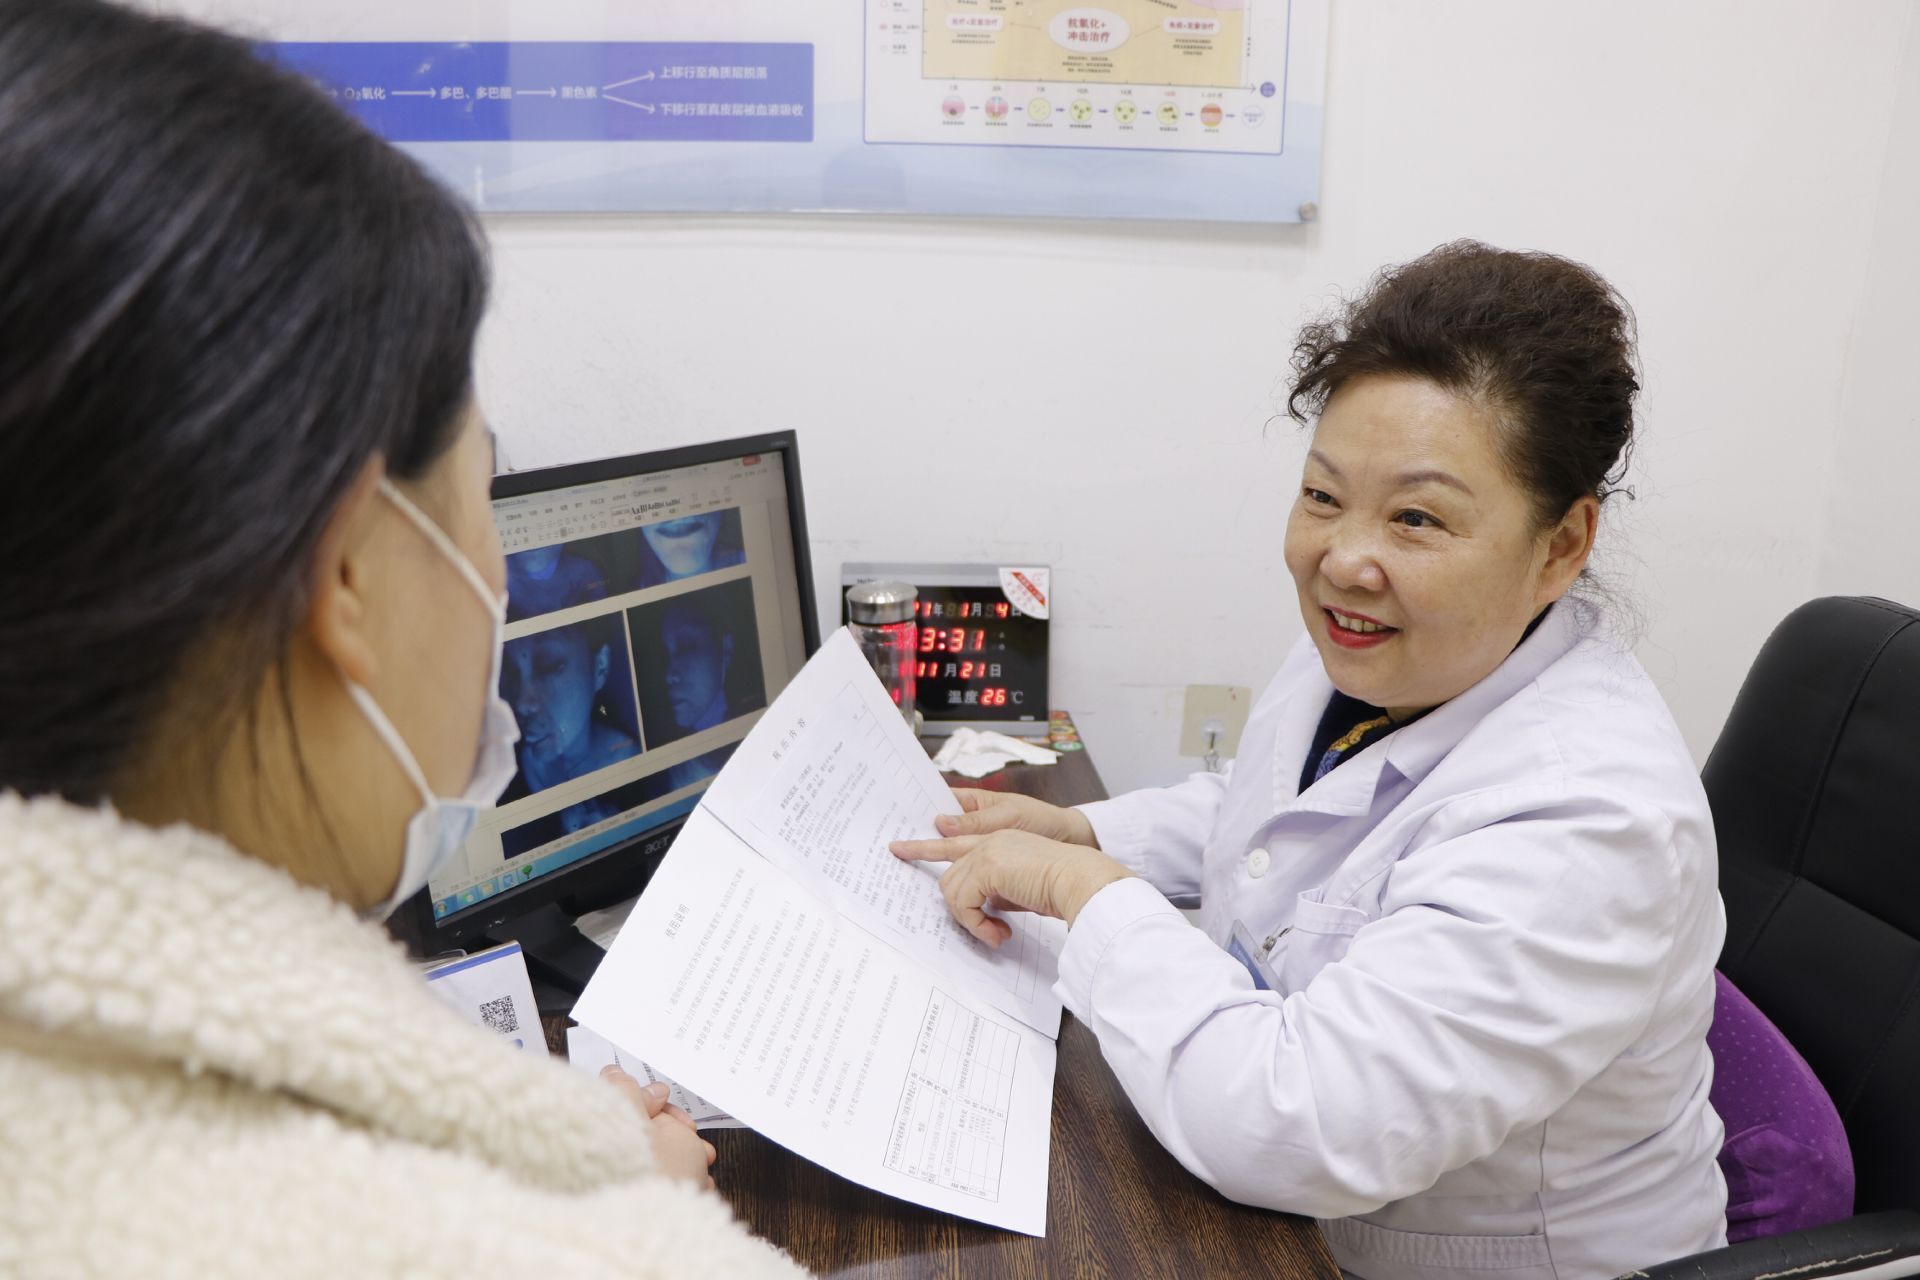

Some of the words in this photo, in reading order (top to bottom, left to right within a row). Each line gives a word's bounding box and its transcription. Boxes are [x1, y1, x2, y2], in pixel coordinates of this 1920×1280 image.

[561, 86, 598, 99] 黑色素
[644, 835, 671, 855] acer
